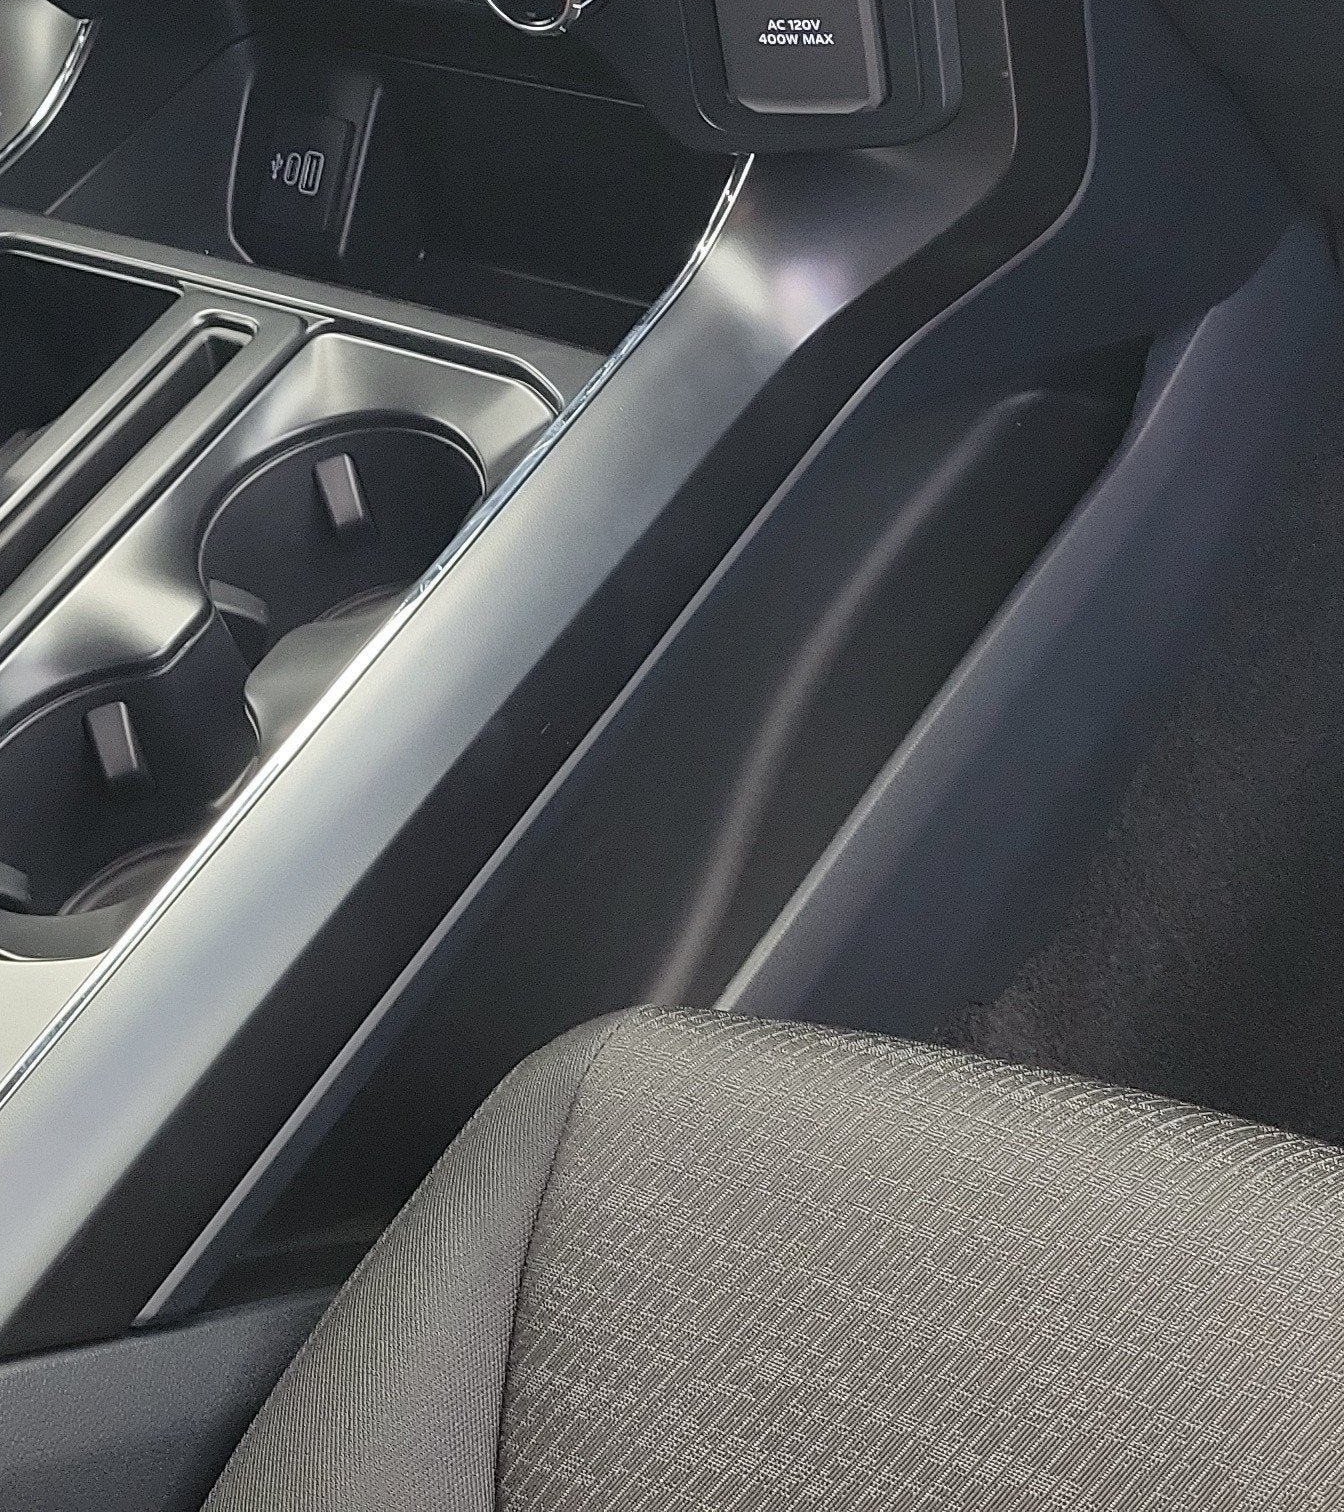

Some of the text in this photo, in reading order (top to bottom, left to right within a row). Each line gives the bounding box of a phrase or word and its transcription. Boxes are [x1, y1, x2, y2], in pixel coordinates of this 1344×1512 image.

[767, 19, 821, 31] AC 120V
[758, 33, 835, 45] 400W MAX
